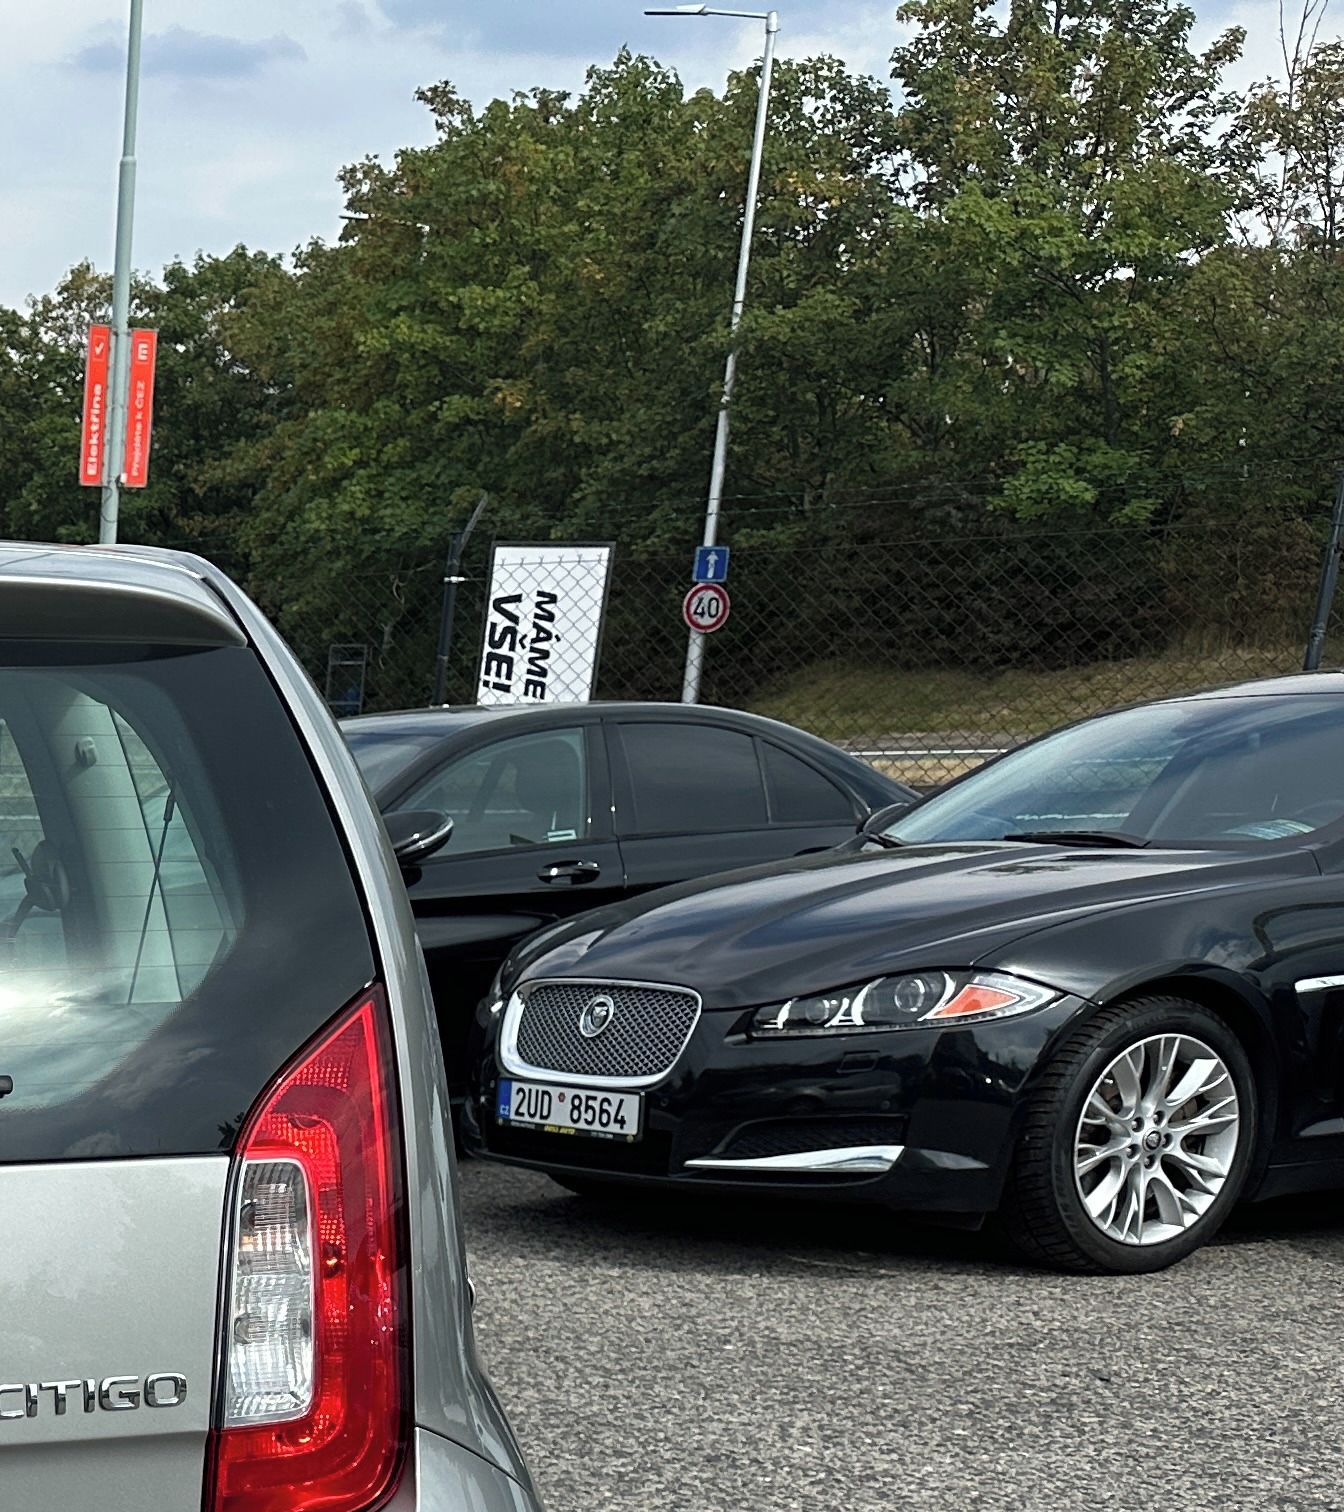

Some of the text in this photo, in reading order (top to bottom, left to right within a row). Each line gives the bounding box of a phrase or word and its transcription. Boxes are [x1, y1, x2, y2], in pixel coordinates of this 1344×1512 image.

[693, 597, 720, 619] 40
[482, 593, 527, 694] VŠE!
[524, 590, 561, 700] MÁME
[499, 1104, 510, 1116] CZ
[514, 1087, 626, 1130] 2UD 8564
